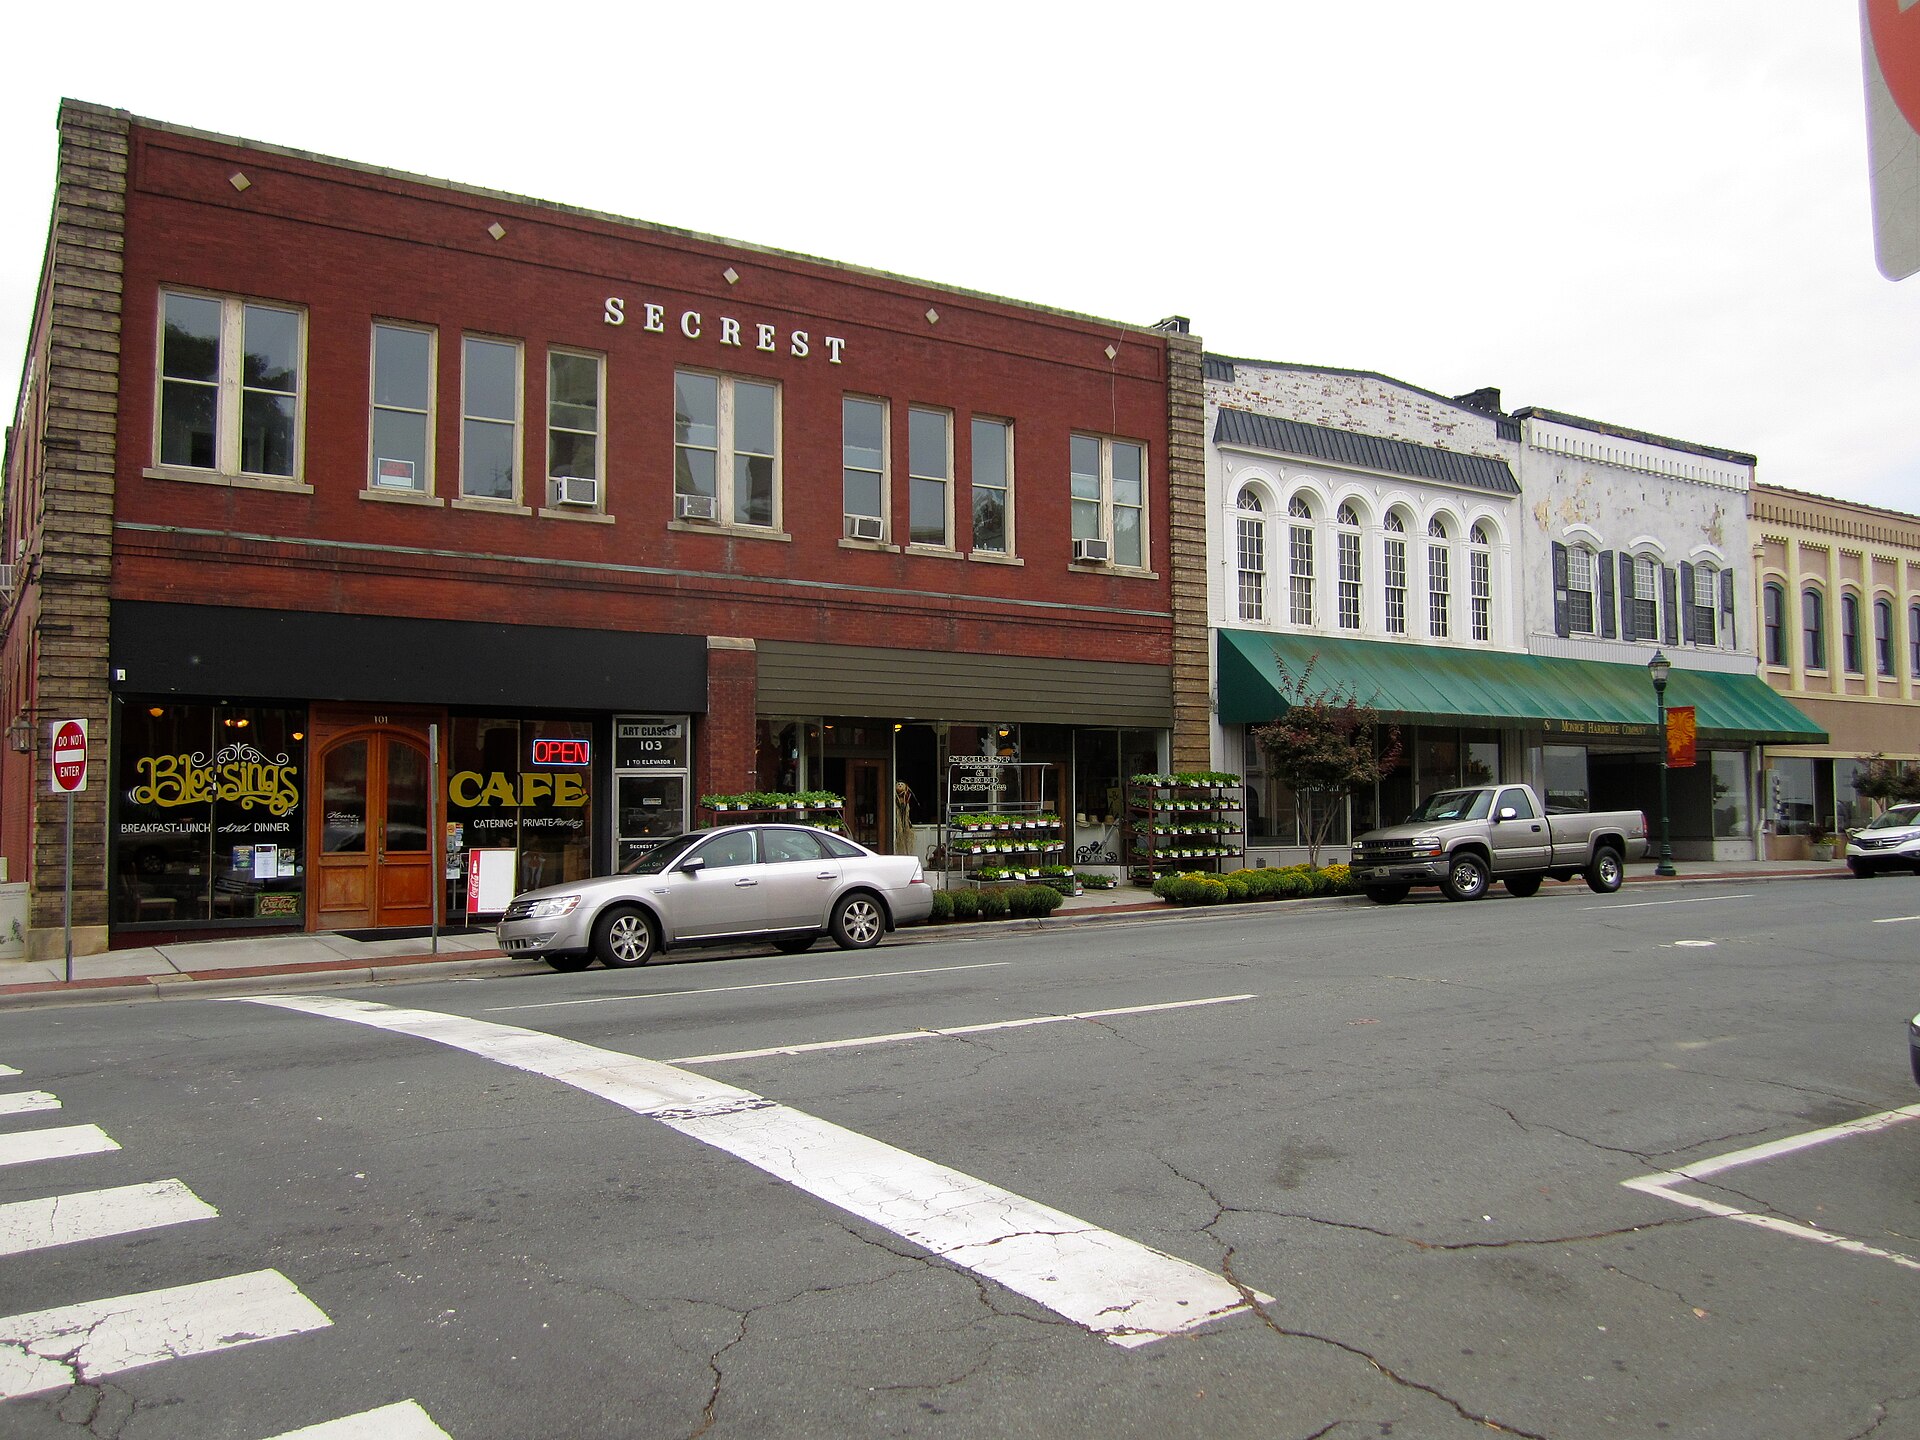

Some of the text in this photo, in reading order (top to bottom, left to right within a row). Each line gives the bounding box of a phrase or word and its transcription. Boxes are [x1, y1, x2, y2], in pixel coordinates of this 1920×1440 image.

[604, 297, 845, 364] SECREST
[374, 716, 388, 724] 101
[623, 727, 677, 736] ART CLASSES
[1561, 720, 1648, 735] MONROE HARDWARE COMPANY
[58, 735, 82, 747] DO NOT
[640, 740, 662, 750] 103
[535, 742, 587, 763] OPEN
[60, 765, 80, 777] ENTER
[135, 754, 299, 815] Blessings
[448, 770, 590, 808] CAFE
[217, 822, 252, 832] And
[254, 822, 290, 832] DINNER
[522, 818, 553, 827] PRIVATE
[552, 817, 584, 829] Parties
